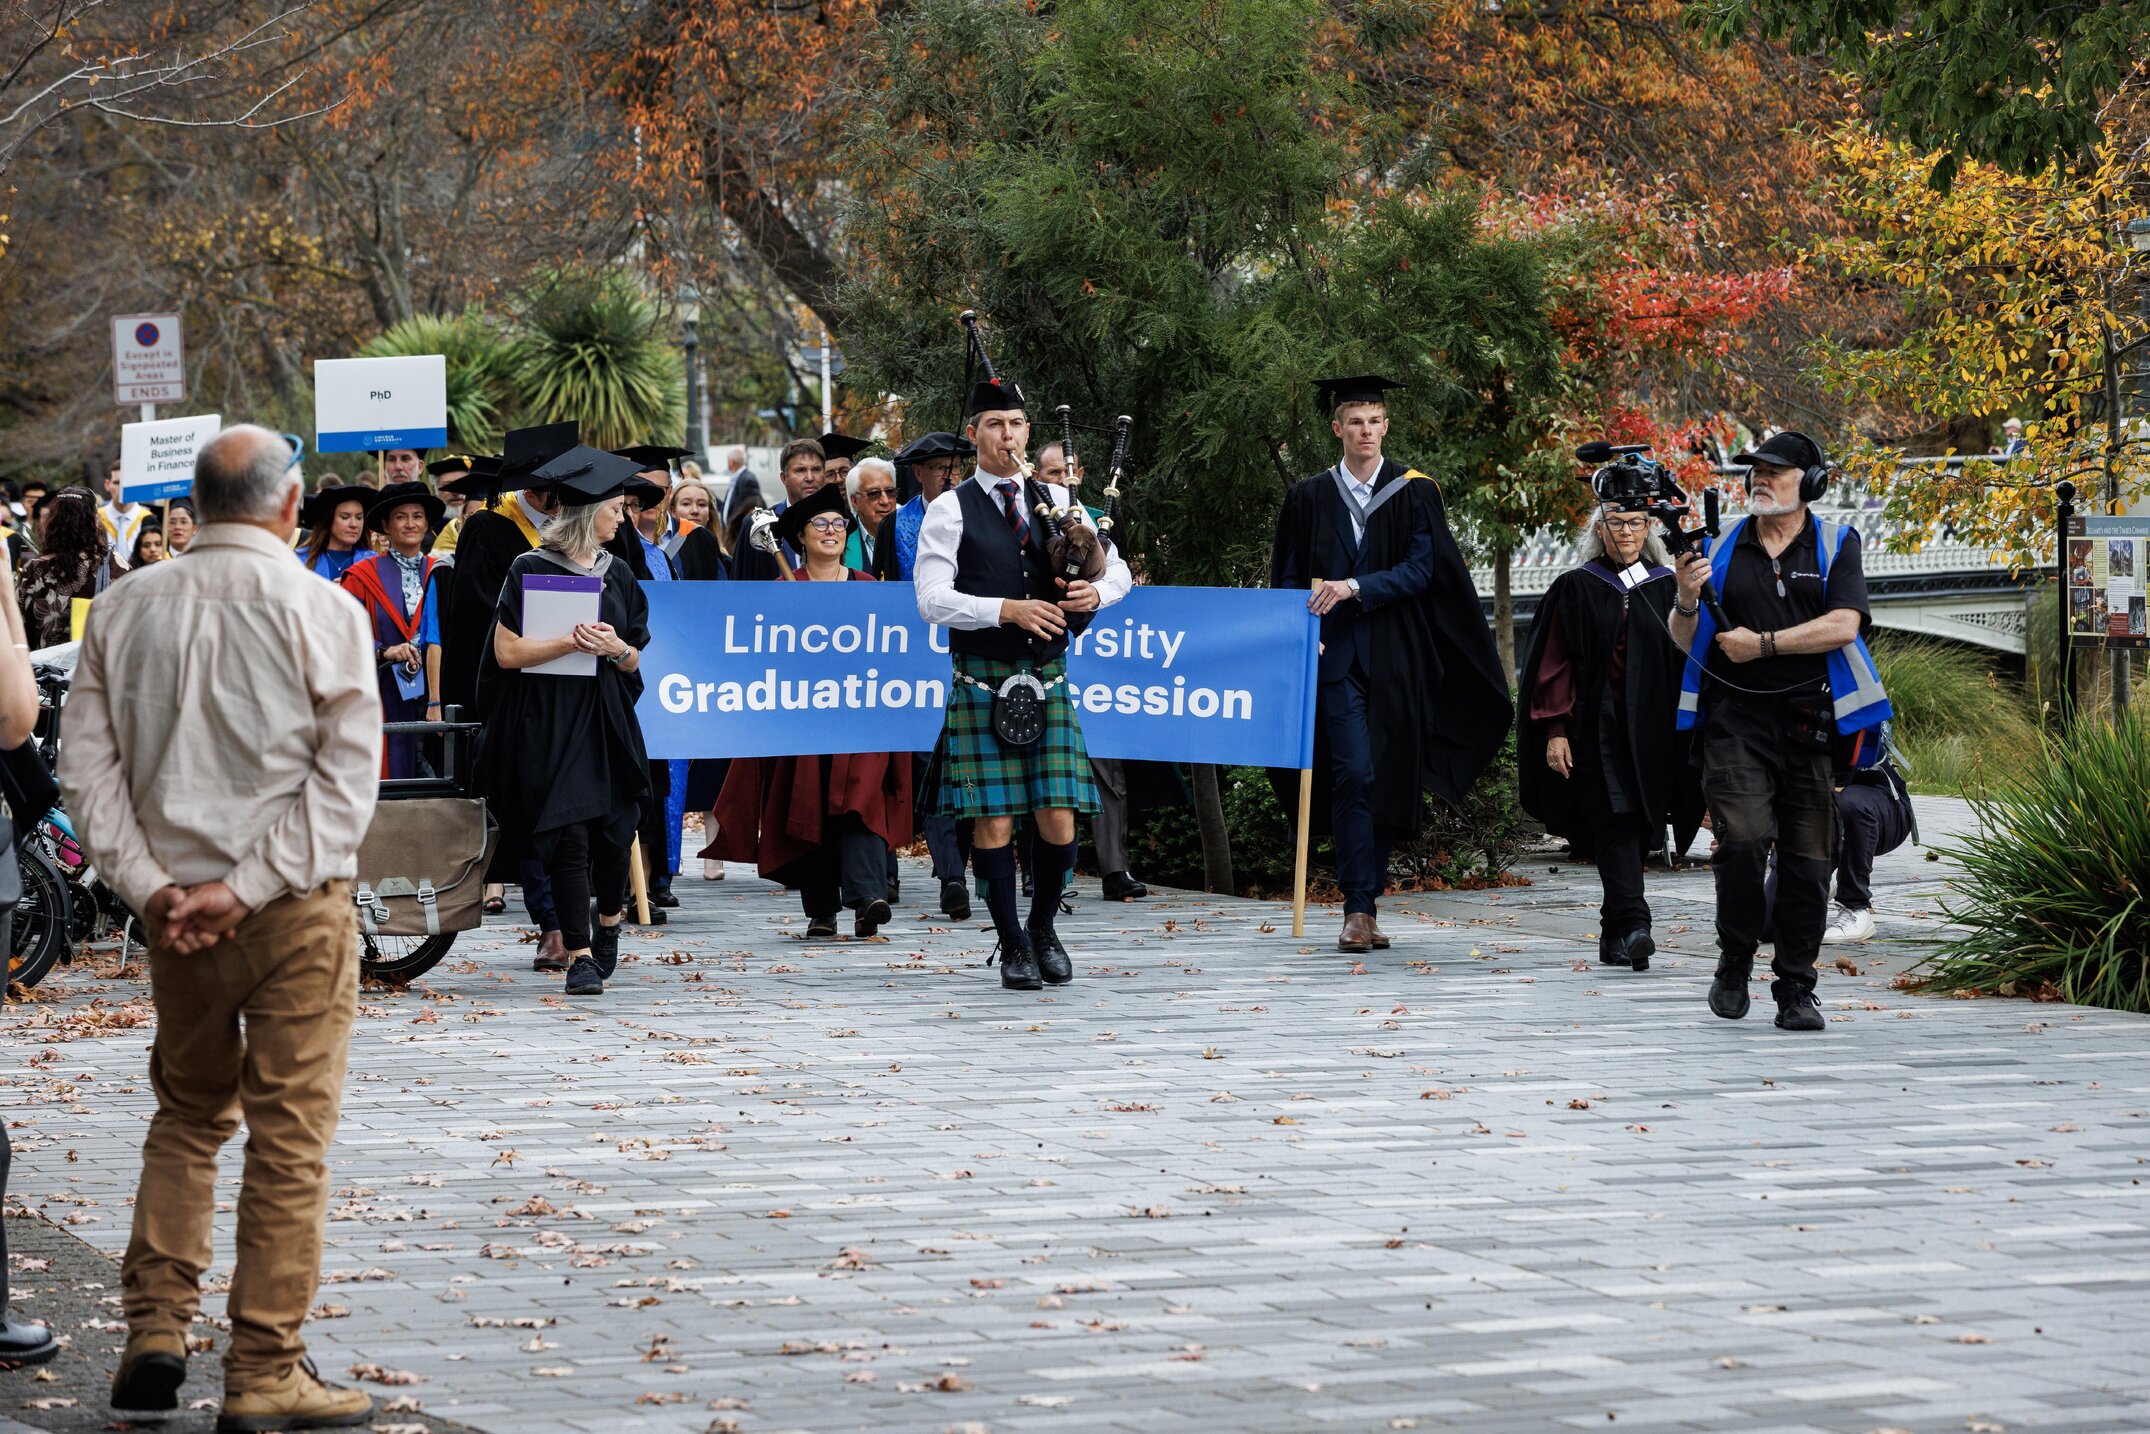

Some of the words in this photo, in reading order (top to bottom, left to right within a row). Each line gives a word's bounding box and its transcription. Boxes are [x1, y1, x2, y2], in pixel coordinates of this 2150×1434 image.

[125, 351, 160, 359] Except
[120, 360, 178, 370] Signposted
[131, 386, 170, 398] ENDS
[370, 390, 392, 400] PhD
[150, 435, 183, 446] Master
[185, 432, 196, 442] of
[151, 447, 192, 459] Business
[147, 463, 156, 472] in
[158, 460, 195, 471] Finance
[724, 613, 909, 653] Lincoln
[658, 668, 945, 714] Graduation
